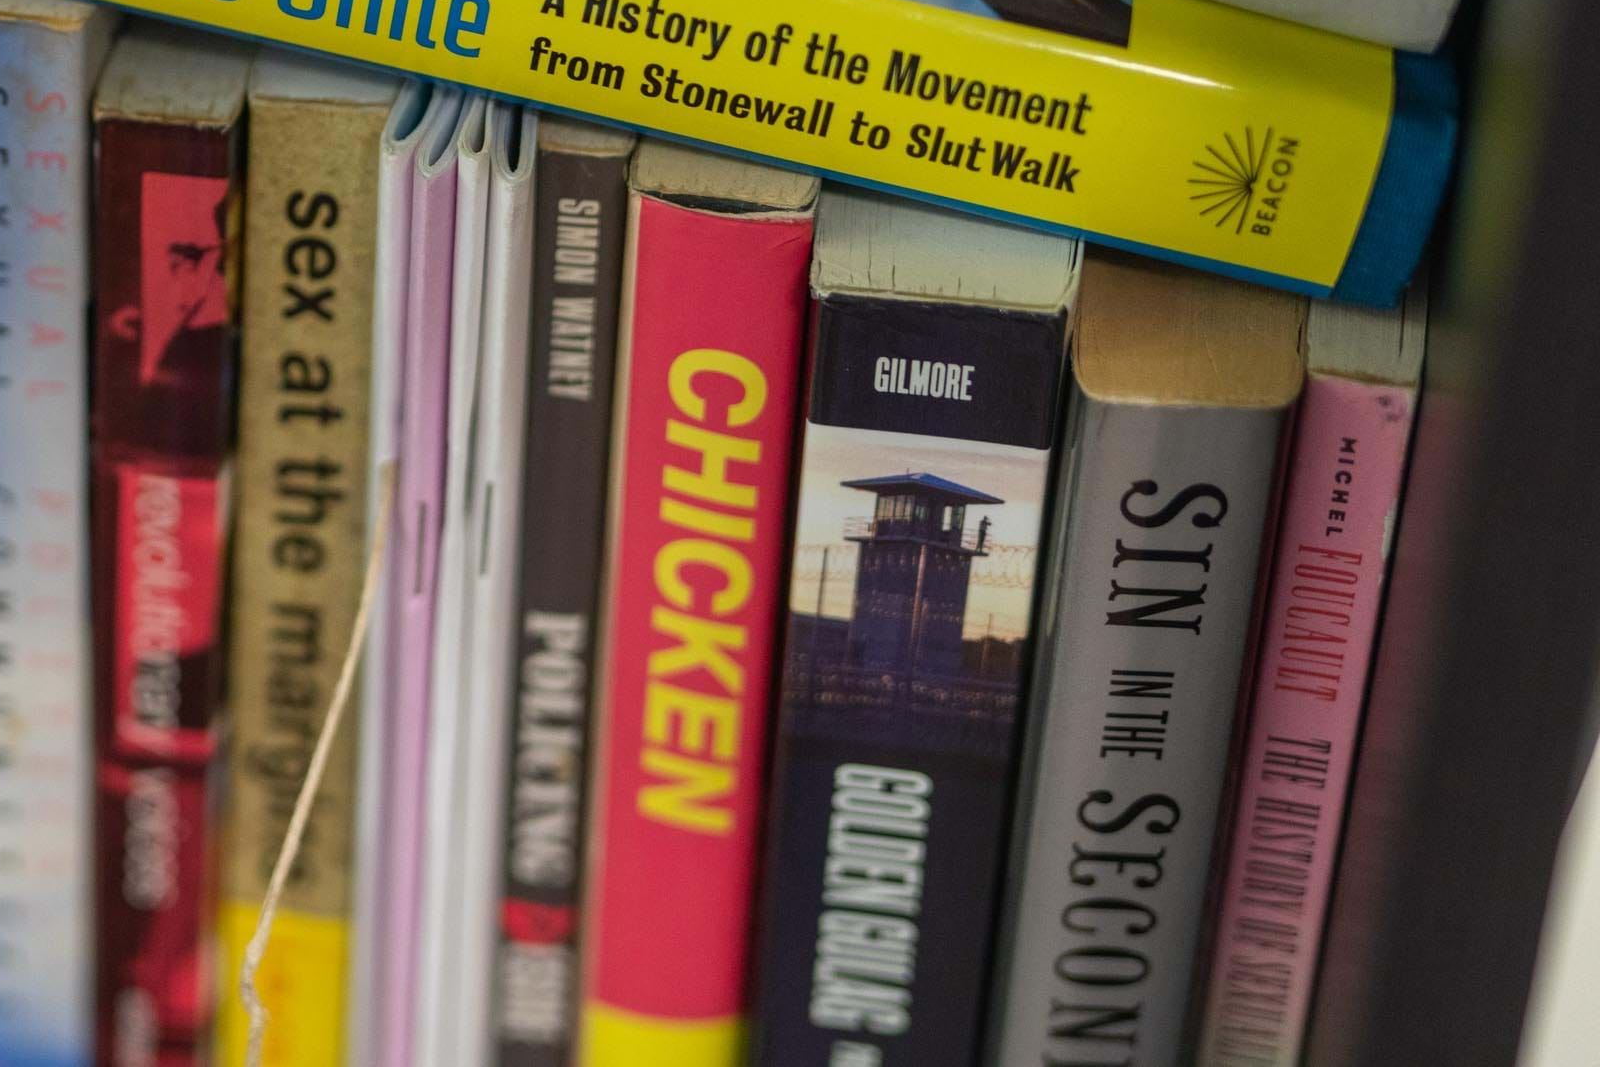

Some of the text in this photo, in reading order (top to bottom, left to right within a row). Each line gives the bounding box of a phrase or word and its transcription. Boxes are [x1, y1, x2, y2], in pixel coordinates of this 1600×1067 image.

[528, 35, 626, 91] from
[638, 62, 833, 138] Stonewall
[849, 108, 891, 152] to
[743, 22, 795, 66] of
[801, 29, 871, 87] the
[883, 49, 1094, 138] Movement
[24, 90, 68, 400] SEXUAL
[1249, 135, 1302, 239] BEACON
[283, 189, 341, 323] sex
[545, 197, 602, 402] SIMON WATNEY
[276, 356, 345, 425] at
[872, 355, 976, 403] GILMORE
[270, 459, 344, 575] the
[1324, 435, 1358, 538] MICHEL
[636, 347, 770, 838] CHICKEN
[1272, 543, 1363, 703] FOUCAULT
[1040, 478, 1230, 1067] SIN IN THE SECON
[1260, 735, 1332, 791] THE
[820, 762, 936, 915] GOLDEN
[807, 909, 920, 1035] GULAG
